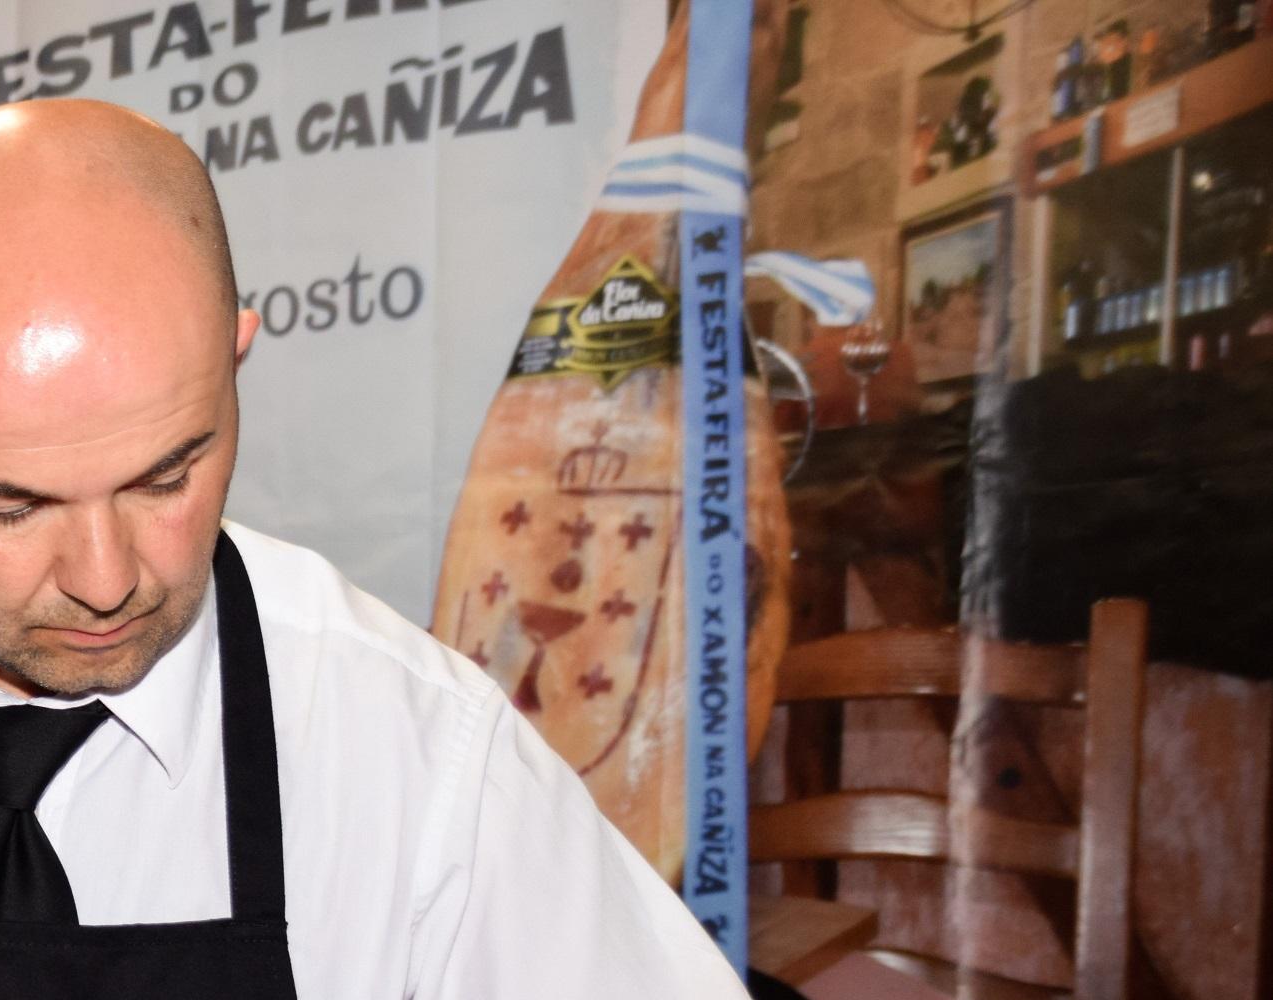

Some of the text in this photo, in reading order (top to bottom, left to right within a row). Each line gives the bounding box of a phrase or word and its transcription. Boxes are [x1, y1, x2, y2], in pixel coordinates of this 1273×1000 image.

[169, 61, 260, 114] DO
[204, 114, 281, 173] NA
[238, 253, 425, 337] osto
[705, 745, 724, 781] NA
